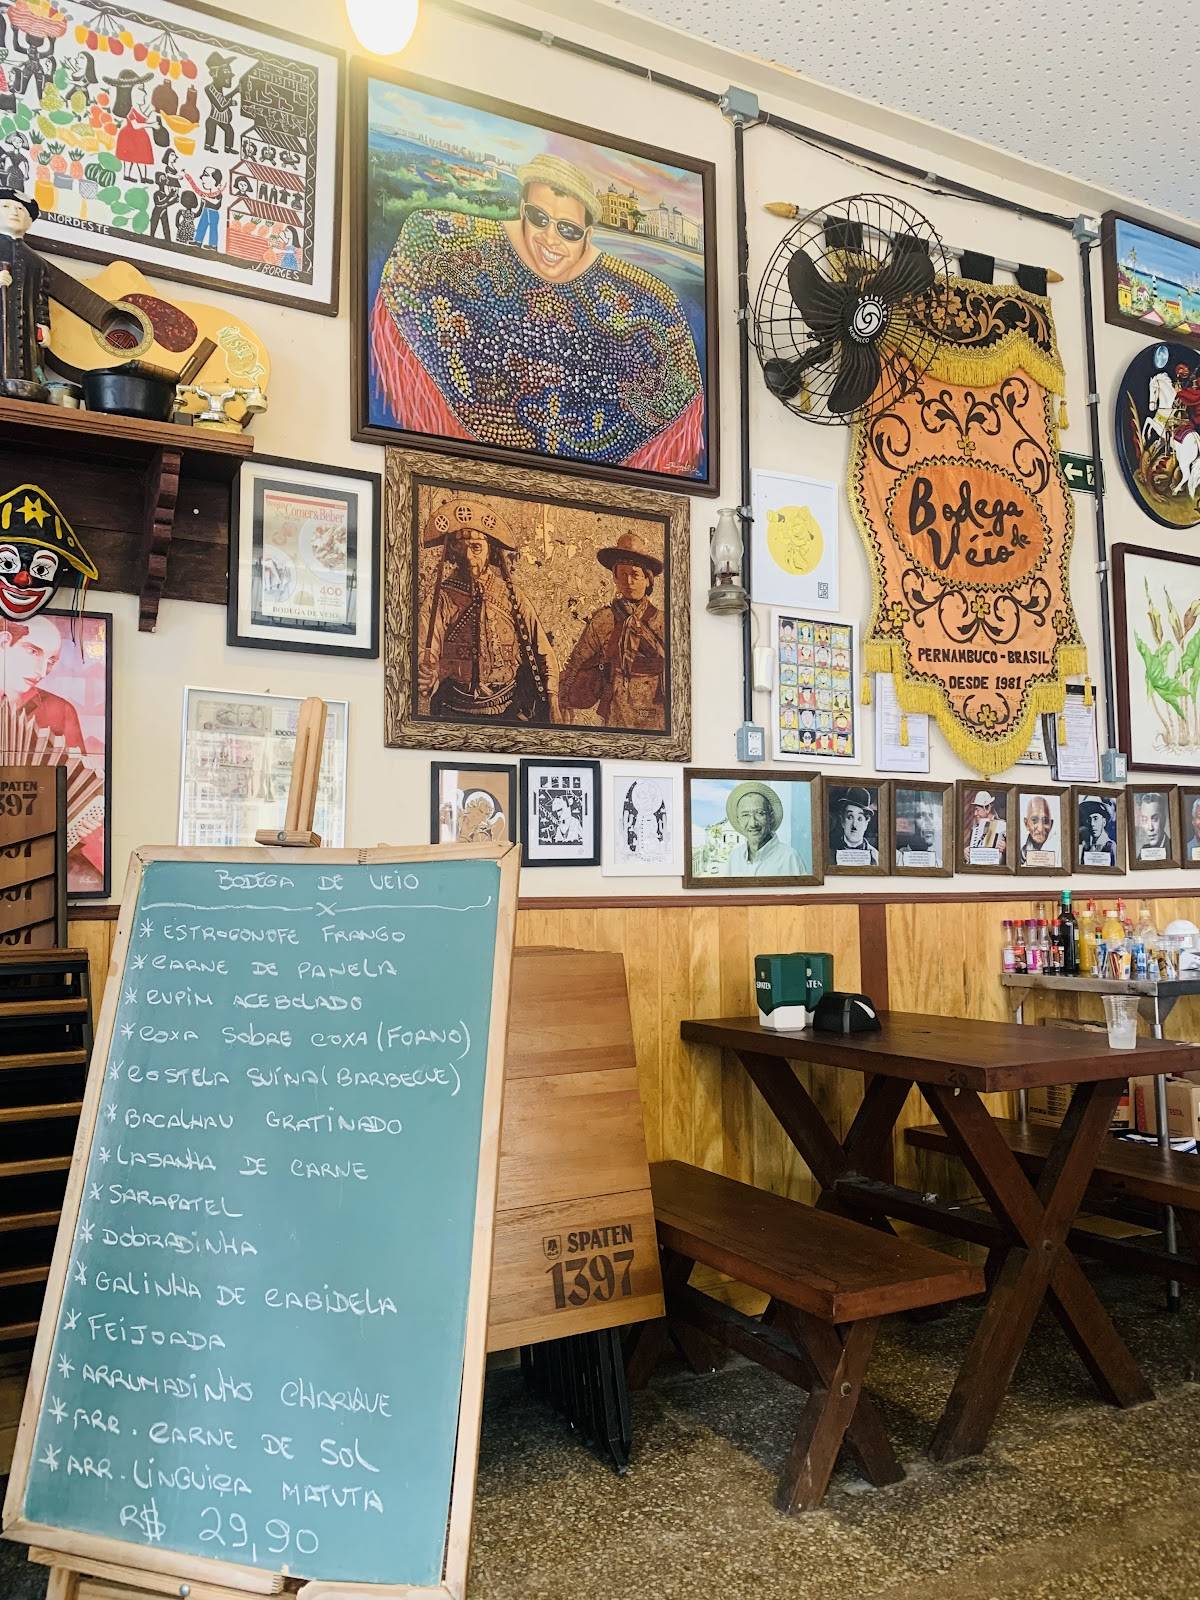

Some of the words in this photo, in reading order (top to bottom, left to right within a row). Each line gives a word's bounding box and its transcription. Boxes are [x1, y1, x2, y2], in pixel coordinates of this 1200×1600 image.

[47, 213, 110, 235] NORDESTE
[262, 264, 300, 280] BORGES
[908, 476, 1024, 537] Bodega
[948, 675, 989, 690] DESDE
[995, 675, 1022, 690] 1981
[0, 780, 38, 792] PATEN
[214, 869, 295, 891] BODEGA
[317, 873, 344, 891] DE
[321, 924, 406, 944] FRANGO
[151, 954, 229, 975] CARNE
[251, 961, 279, 977] DE
[297, 957, 400, 979] PANELA
[139, 1025, 200, 1044] COXA
[310, 1030, 368, 1049] COXA
[126, 1064, 230, 1088] COSTELA
[124, 1107, 235, 1130] BACALHAU
[116, 1144, 217, 1172] LASANHA
[238, 1156, 269, 1176] DE
[290, 1158, 369, 1181] CARNE
[108, 1183, 244, 1218] SARAPATEL
[566, 1223, 633, 1254] SPATEN
[544, 1248, 635, 1310] 1397
[215, 1285, 247, 1306] DE
[149, 1421, 239, 1450] CARNE
[260, 1433, 295, 1460] DE
[319, 1437, 382, 1474] SOL
[281, 1480, 384, 1514] MATUTA
[119, 1496, 167, 1544] R$
[198, 1506, 320, 1564] 29,90
